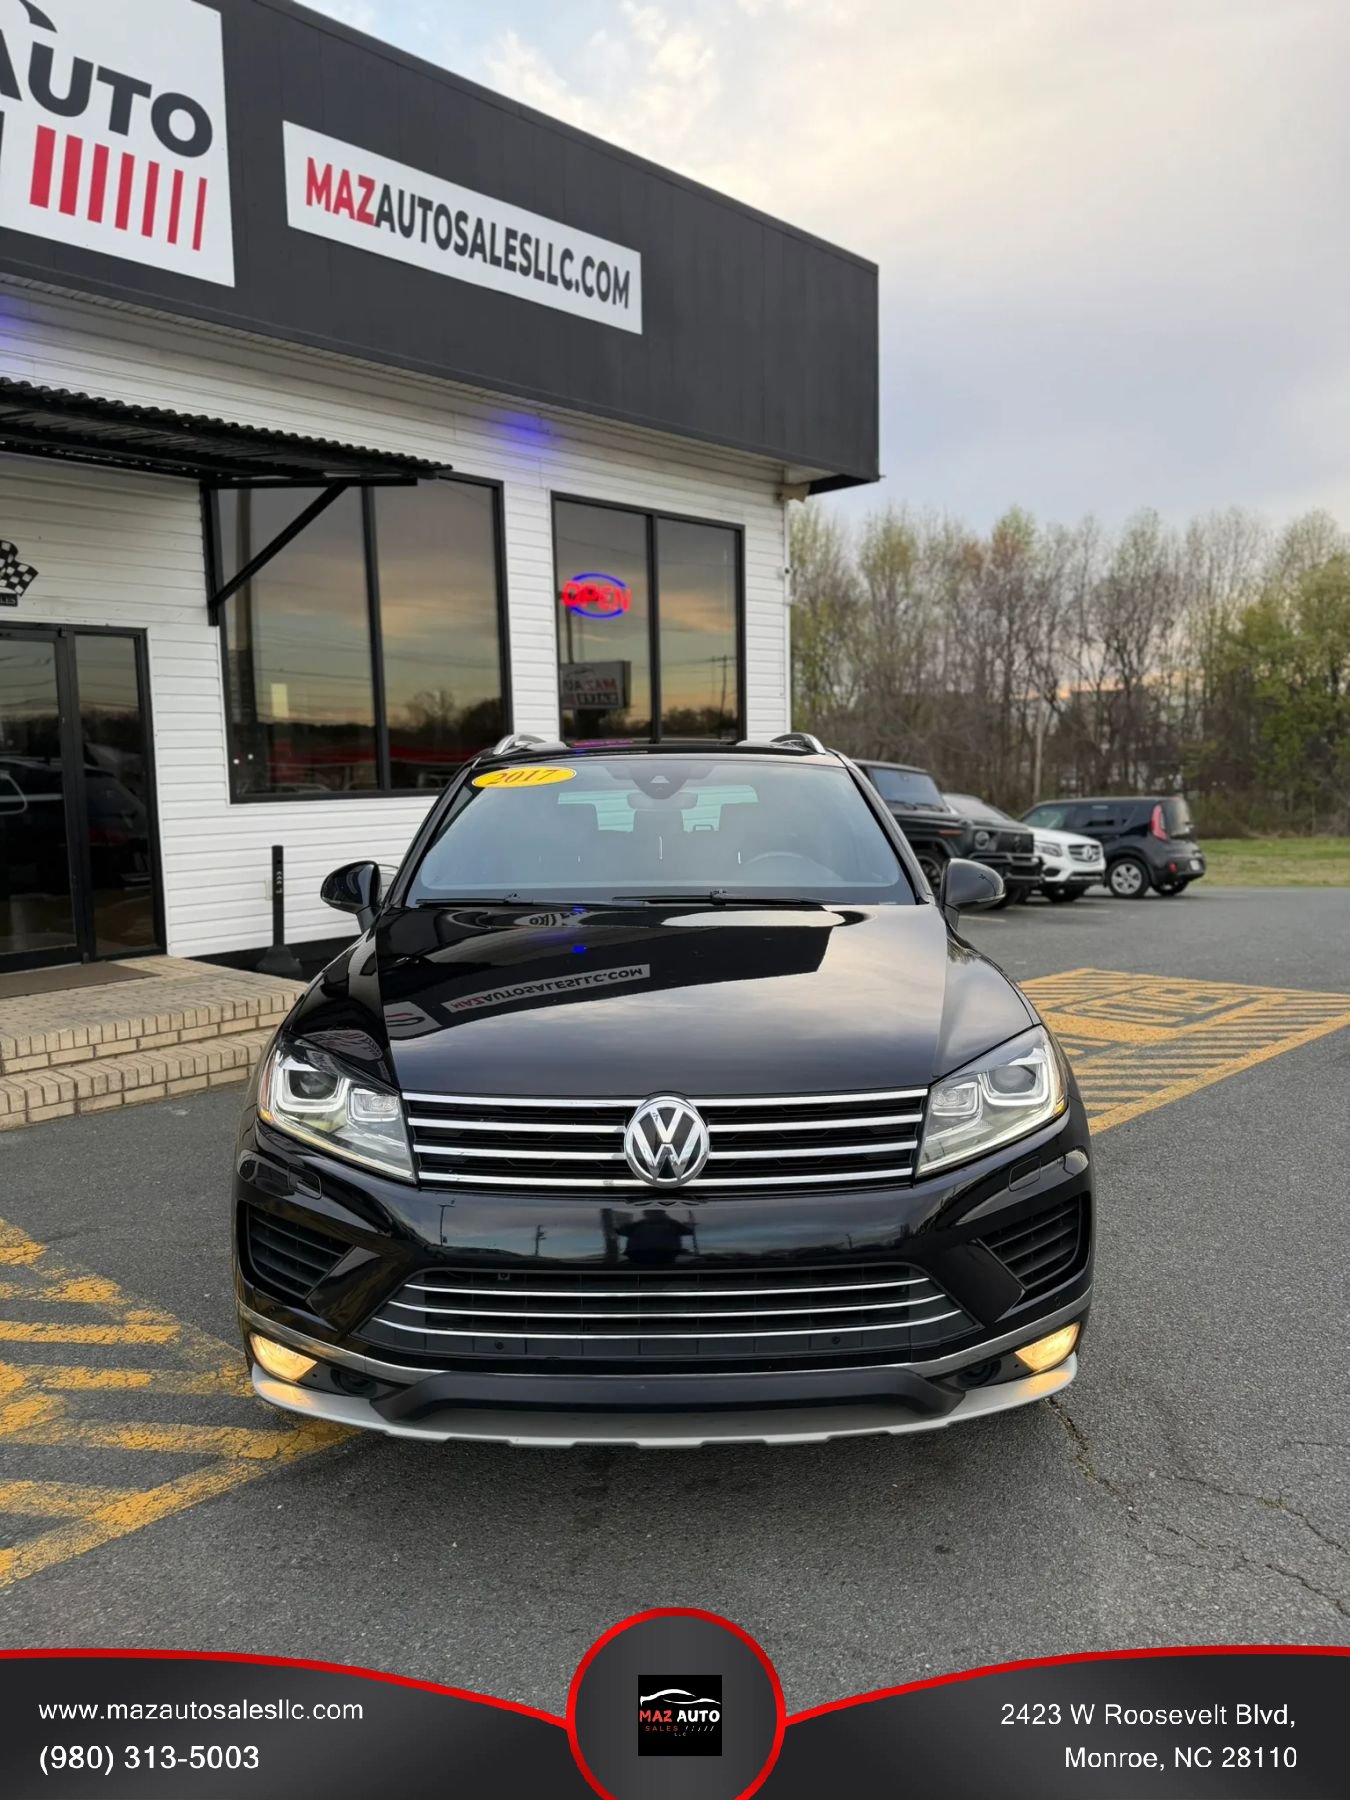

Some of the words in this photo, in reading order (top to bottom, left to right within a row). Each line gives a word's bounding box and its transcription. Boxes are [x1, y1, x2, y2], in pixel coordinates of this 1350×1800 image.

[306, 156, 630, 309] MAZAUTOSALESLLC.COM
[562, 580, 632, 612] OPEN
[487, 769, 560, 785] 2017
